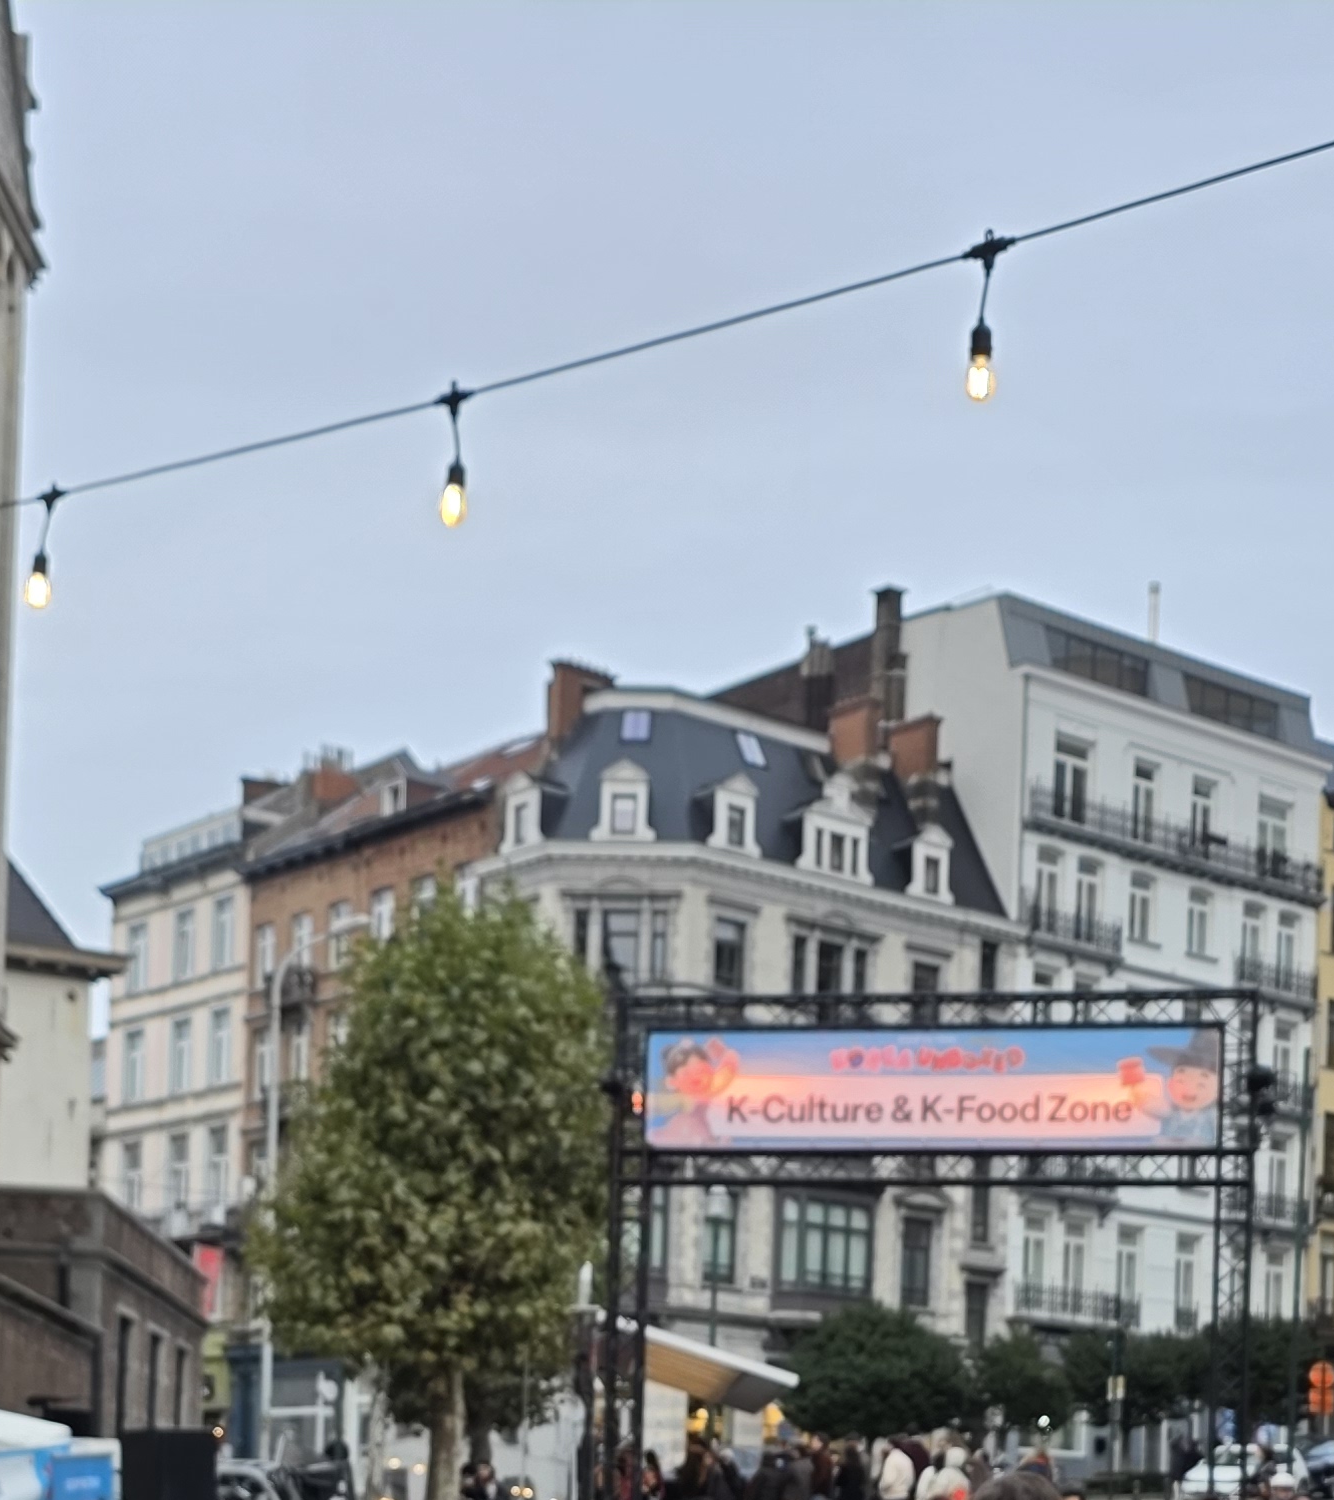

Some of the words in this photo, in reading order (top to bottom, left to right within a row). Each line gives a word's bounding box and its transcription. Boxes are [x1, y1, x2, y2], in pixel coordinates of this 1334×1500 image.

[727, 1094, 884, 1124] K-Culture
[891, 1094, 913, 1124] &
[920, 1094, 1040, 1124] K-Food
[1047, 1094, 1132, 1124] Zone
